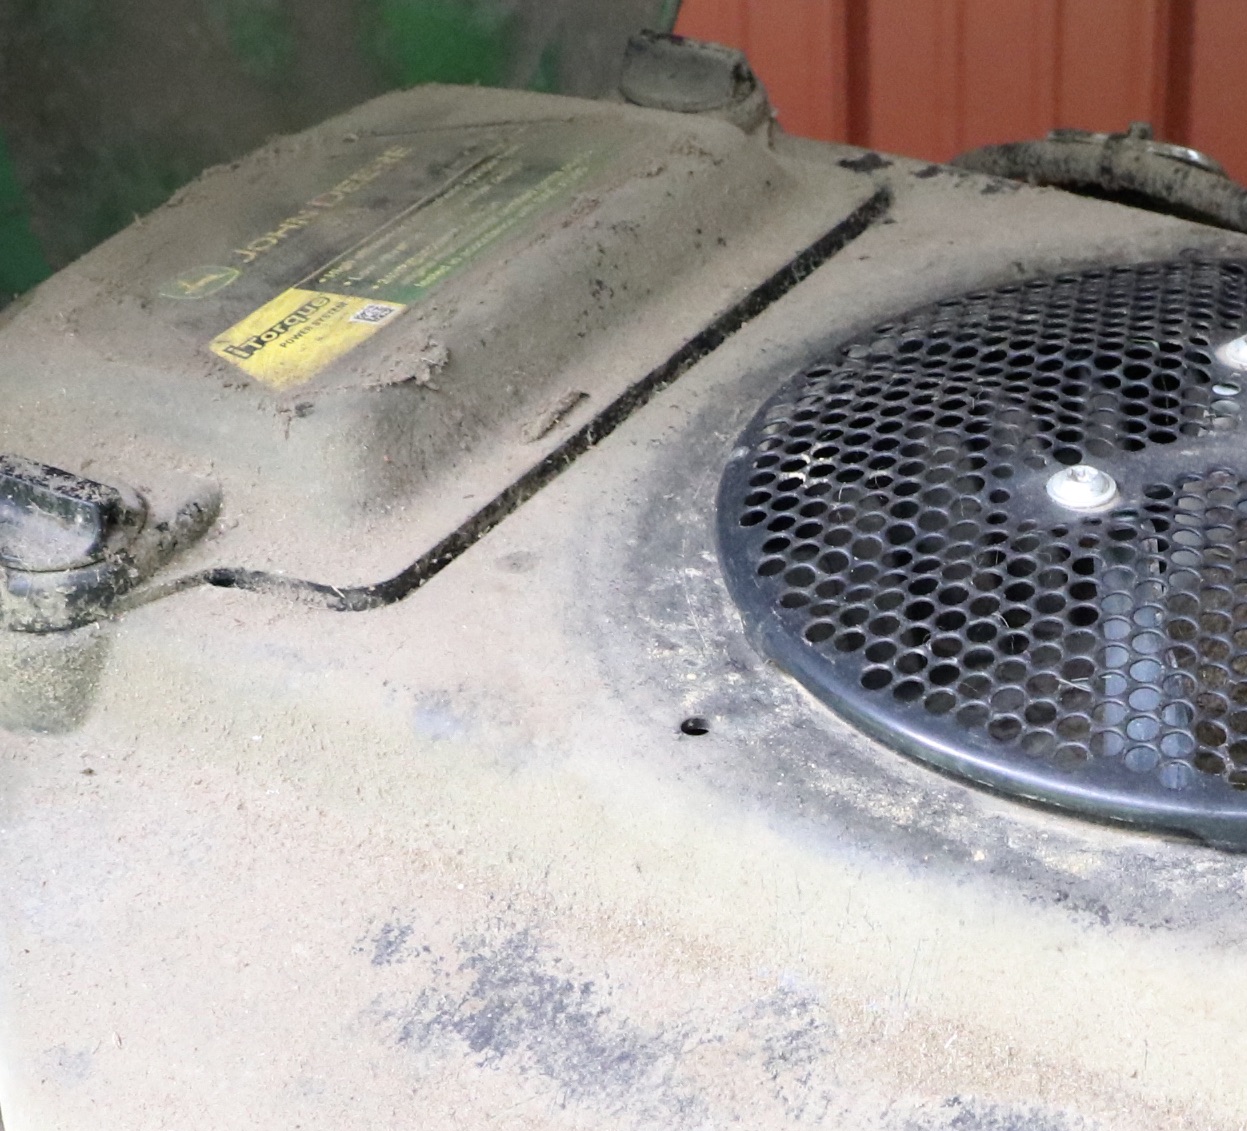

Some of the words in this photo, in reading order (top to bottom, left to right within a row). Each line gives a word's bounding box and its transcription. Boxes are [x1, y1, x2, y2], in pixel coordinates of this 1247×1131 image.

[234, 210, 319, 264] JOHN
[223, 296, 331, 360] iTorque
[279, 325, 314, 349] POWER
[313, 301, 349, 328] SYSTEM
